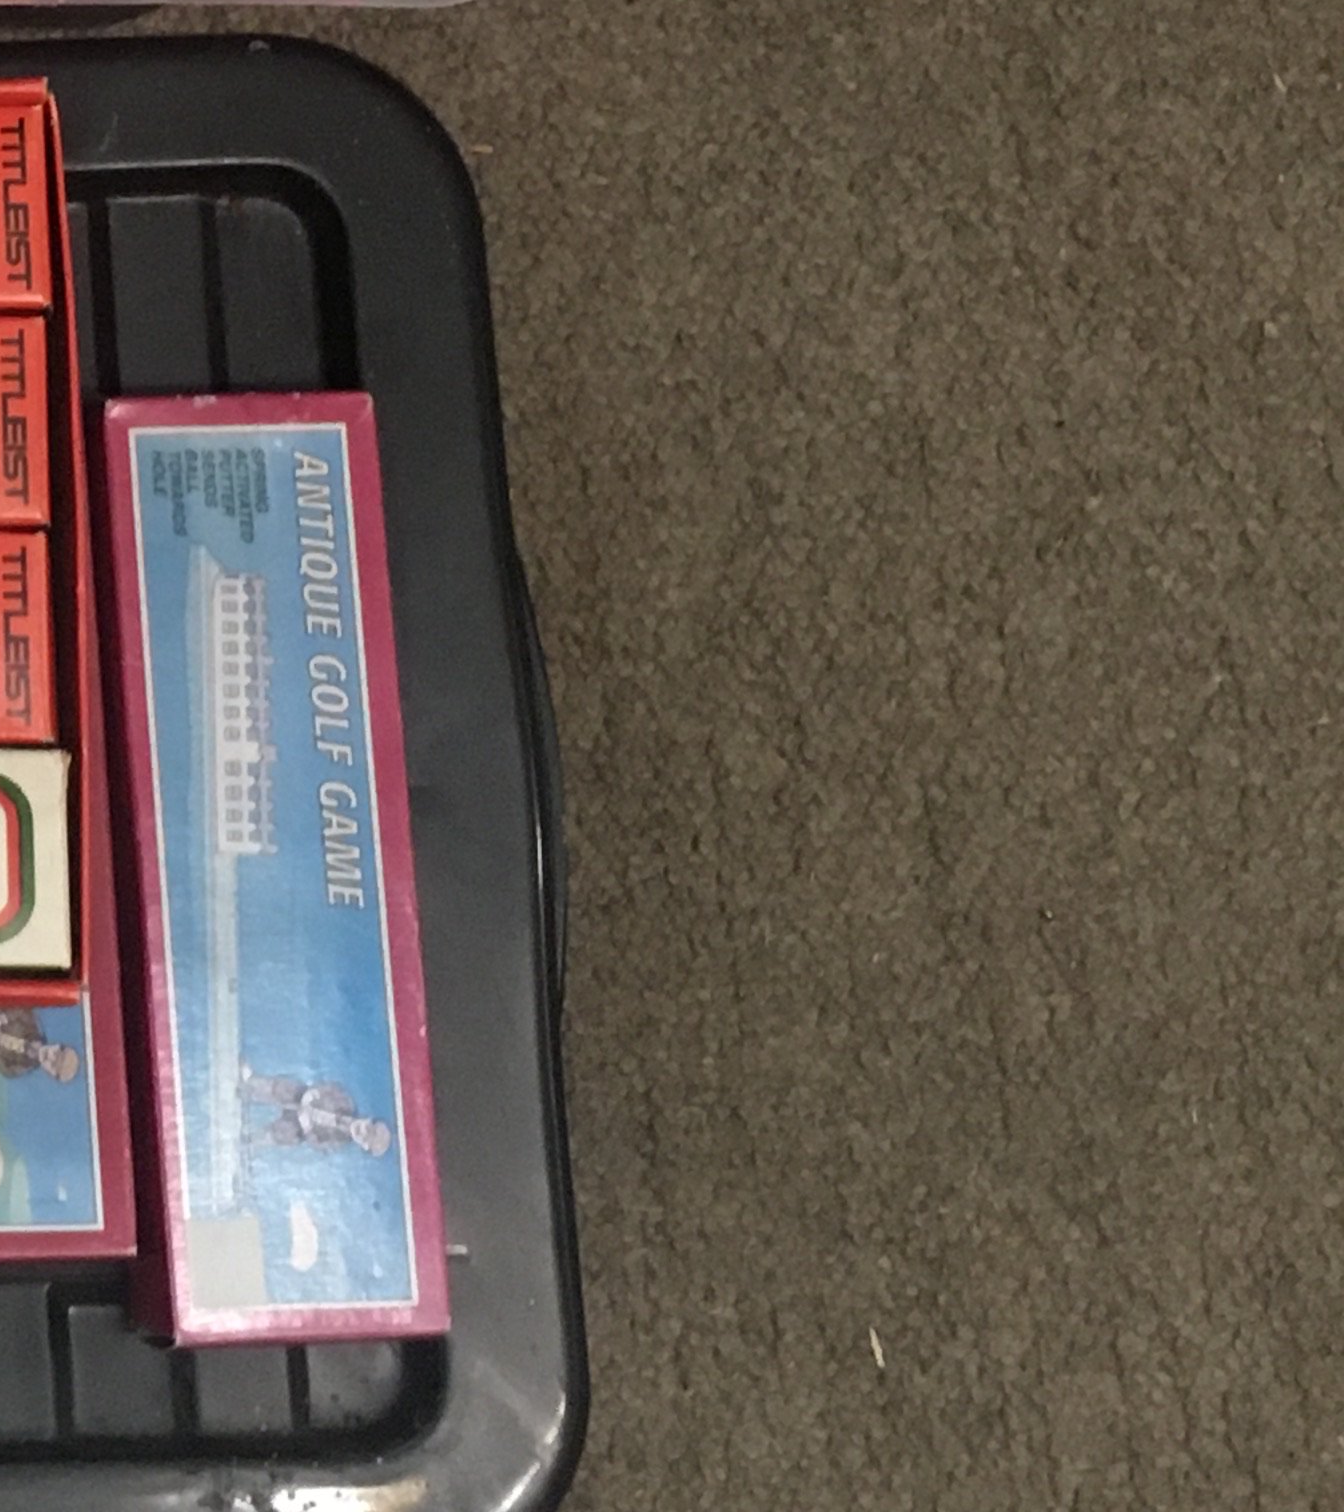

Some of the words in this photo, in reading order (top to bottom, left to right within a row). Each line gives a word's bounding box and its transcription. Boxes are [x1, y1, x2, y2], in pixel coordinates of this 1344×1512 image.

[0, 117, 32, 290] TITLEIST
[0, 328, 29, 505] TITLEIST
[294, 451, 342, 638] ANTIQUE
[2, 546, 32, 726] TITLEIST
[308, 655, 353, 767] GOLF
[319, 781, 365, 909] GAME
